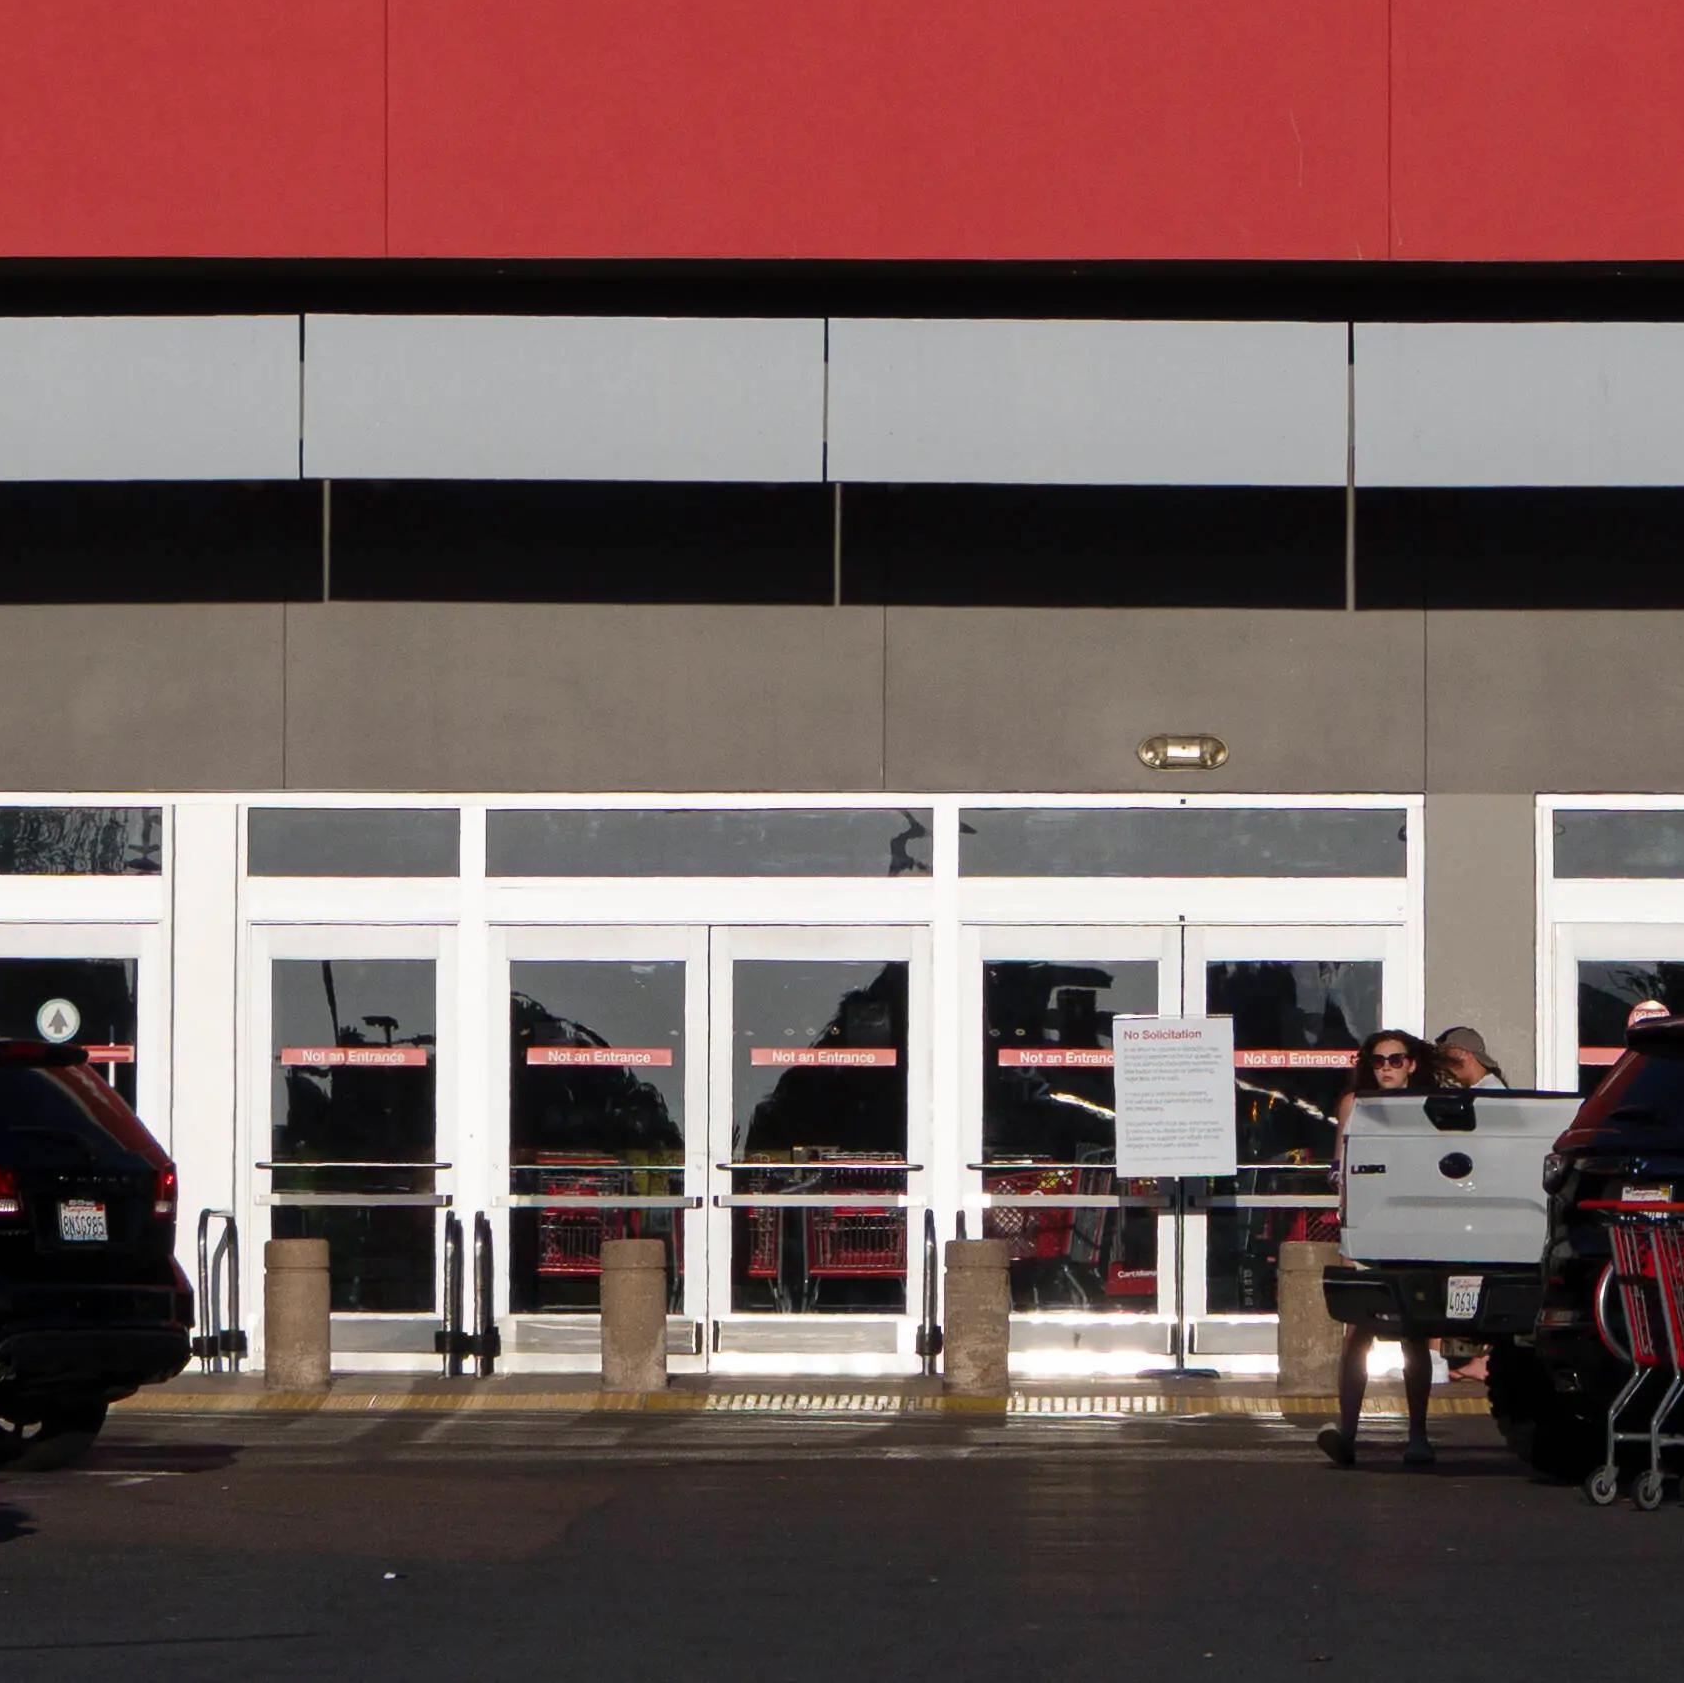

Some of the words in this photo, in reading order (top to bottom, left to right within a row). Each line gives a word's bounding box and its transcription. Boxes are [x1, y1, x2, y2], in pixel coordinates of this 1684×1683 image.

[1123, 1030, 1139, 1040] No
[1142, 1028, 1203, 1040] Solicitation
[301, 1050, 324, 1063] Not
[329, 1053, 345, 1063] an
[348, 1050, 405, 1063] Entrance
[548, 1050, 571, 1063] Not
[575, 1053, 590, 1063] an
[594, 1050, 651, 1063] Entrance
[772, 1051, 795, 1064] Not
[799, 1054, 815, 1064] an
[818, 1051, 875, 1064] Entrance
[1020, 1051, 1043, 1064] Not
[1046, 1054, 1062, 1064] an
[1065, 1051, 1114, 1064] Entranc
[1244, 1052, 1267, 1065] Not
[1271, 1055, 1286, 1065] an
[1289, 1052, 1347, 1065] Entrance
